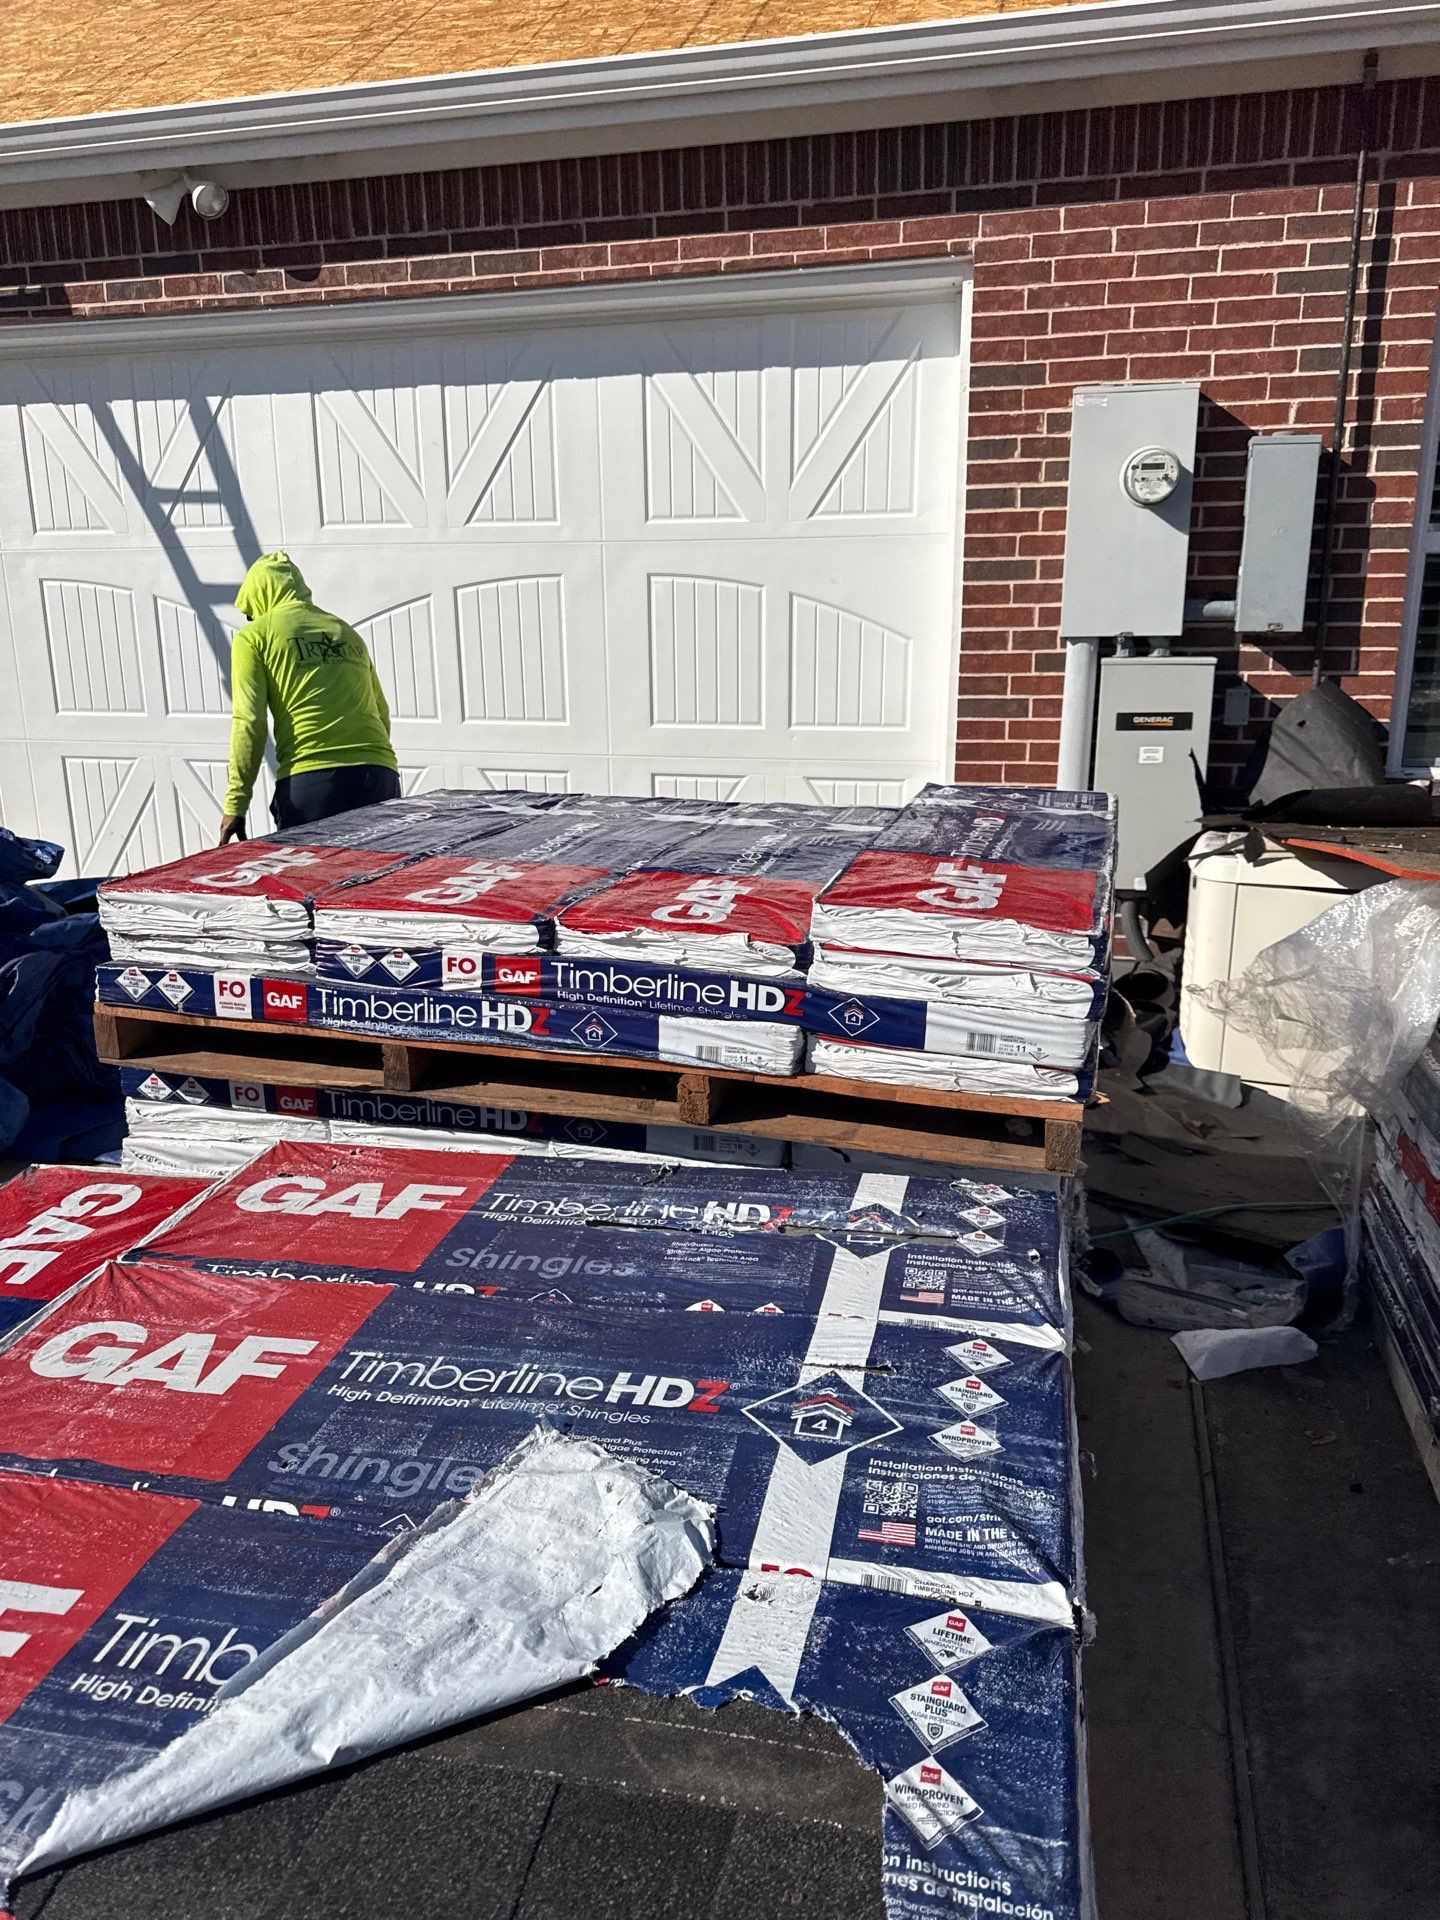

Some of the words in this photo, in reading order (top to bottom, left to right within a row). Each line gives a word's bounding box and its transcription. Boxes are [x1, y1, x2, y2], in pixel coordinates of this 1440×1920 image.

[1132, 716, 1174, 724] GENERAC
[190, 846, 322, 889] GAF
[404, 861, 526, 905] GAF
[915, 861, 1008, 909] GAF
[651, 879, 754, 924] GAF
[447, 956, 477, 974] FO
[498, 968, 538, 984] GAF
[551, 962, 726, 1006] Timberline
[218, 980, 246, 998] FO
[557, 991, 584, 1002] High
[266, 991, 303, 1009] GAF
[315, 987, 478, 1028] Timberline
[1016, 1045, 1026, 1053] 11
[234, 1087, 260, 1101] FO
[280, 1096, 314, 1111] GAF
[324, 1090, 477, 1127] Timberline
[235, 1176, 467, 1219] GAF
[482, 1211, 518, 1223] High
[521, 1215, 588, 1227] Definitio
[0, 1183, 142, 1285] GAF
[906, 1259, 973, 1271] Instrucciones
[907, 1253, 963, 1264] Installation
[951, 1294, 980, 1302] MADE
[996, 1298, 1014, 1306] THE
[30, 1320, 320, 1395] GAF
[338, 1352, 604, 1401] Timberline
[949, 1386, 994, 1399] STAINGUARD
[327, 1384, 372, 1402] High
[566, 1406, 651, 1424] Shingles
[811, 1419, 828, 1432] 4
[941, 1433, 992, 1446] WINDPROVEN
[601, 1443, 631, 1453] Algae
[652, 1457, 680, 1466] Area
[267, 1443, 487, 1497] Shingle
[868, 1466, 955, 1480] Instrucciones
[958, 1473, 977, 1481] de
[869, 1458, 943, 1472] Installation
[946, 1465, 1024, 1487] instructions
[925, 1526, 963, 1541] MADE
[967, 1528, 980, 1542] IN
[983, 1527, 1007, 1540] THE
[913, 1584, 957, 1597] TIMBERLINE
[958, 1590, 974, 1598] HDZ
[914, 1579, 955, 1590] CHARCOAL
[948, 1619, 965, 1628] GAF
[92, 1613, 259, 1686] Timb
[923, 1638, 959, 1652] WARRANTY
[69, 1673, 131, 1702] High
[933, 1685, 950, 1693] GAF
[910, 1693, 967, 1715] STAINGUARD
[910, 1710, 928, 1721] ALGAE
[922, 1771, 940, 1780] GAF
[882, 1853, 901, 1868] on
[905, 1854, 1012, 1896] instructions
[923, 1879, 949, 1898] de
[952, 1887, 1054, 1920] instalación
